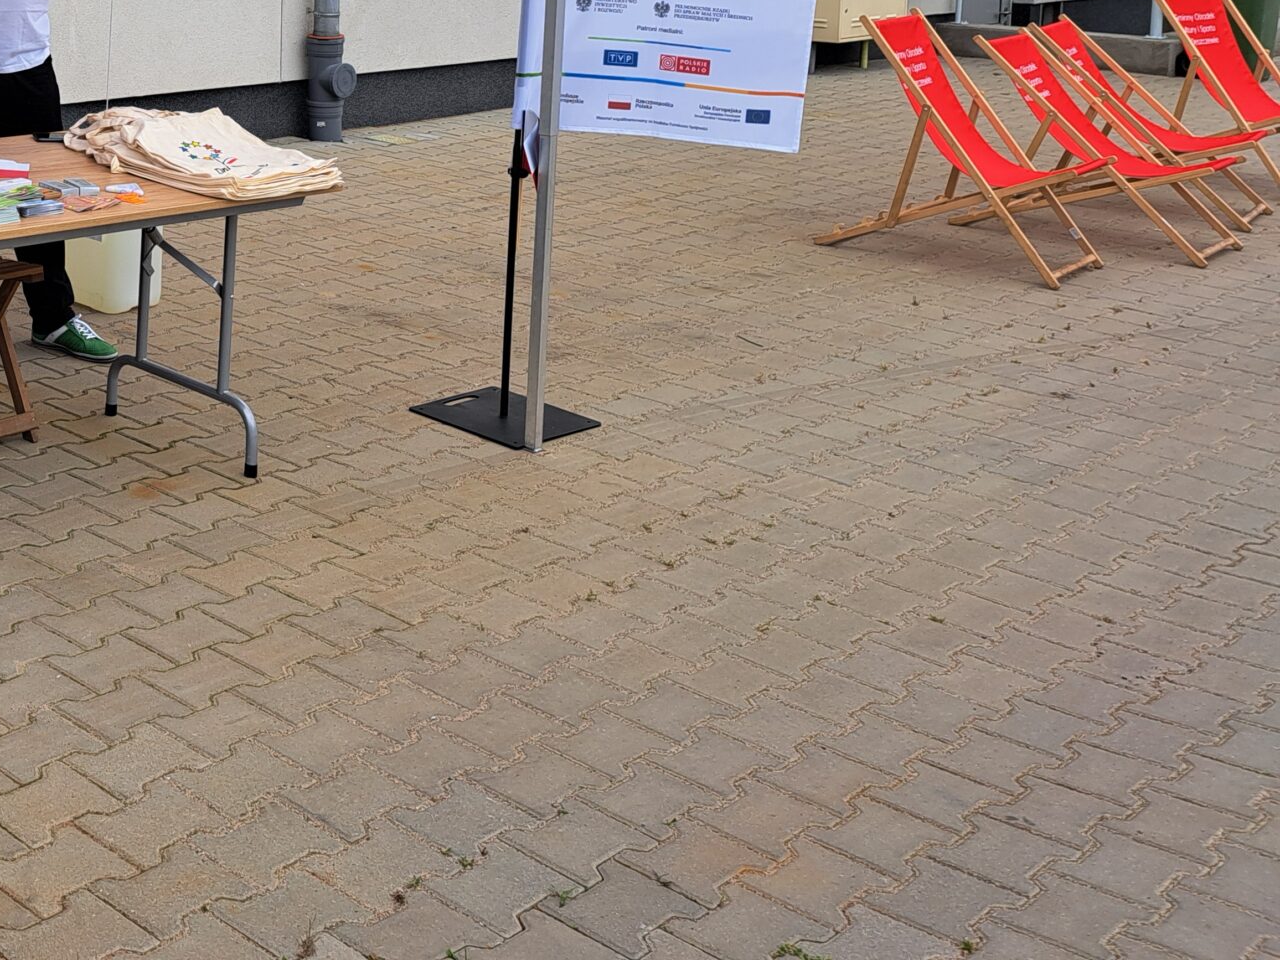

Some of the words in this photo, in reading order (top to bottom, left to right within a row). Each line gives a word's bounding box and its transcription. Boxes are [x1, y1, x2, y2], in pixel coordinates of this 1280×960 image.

[608, 52, 634, 64] TVP
[679, 58, 709, 68] POLSKIE
[678, 65, 708, 74] RADIO
